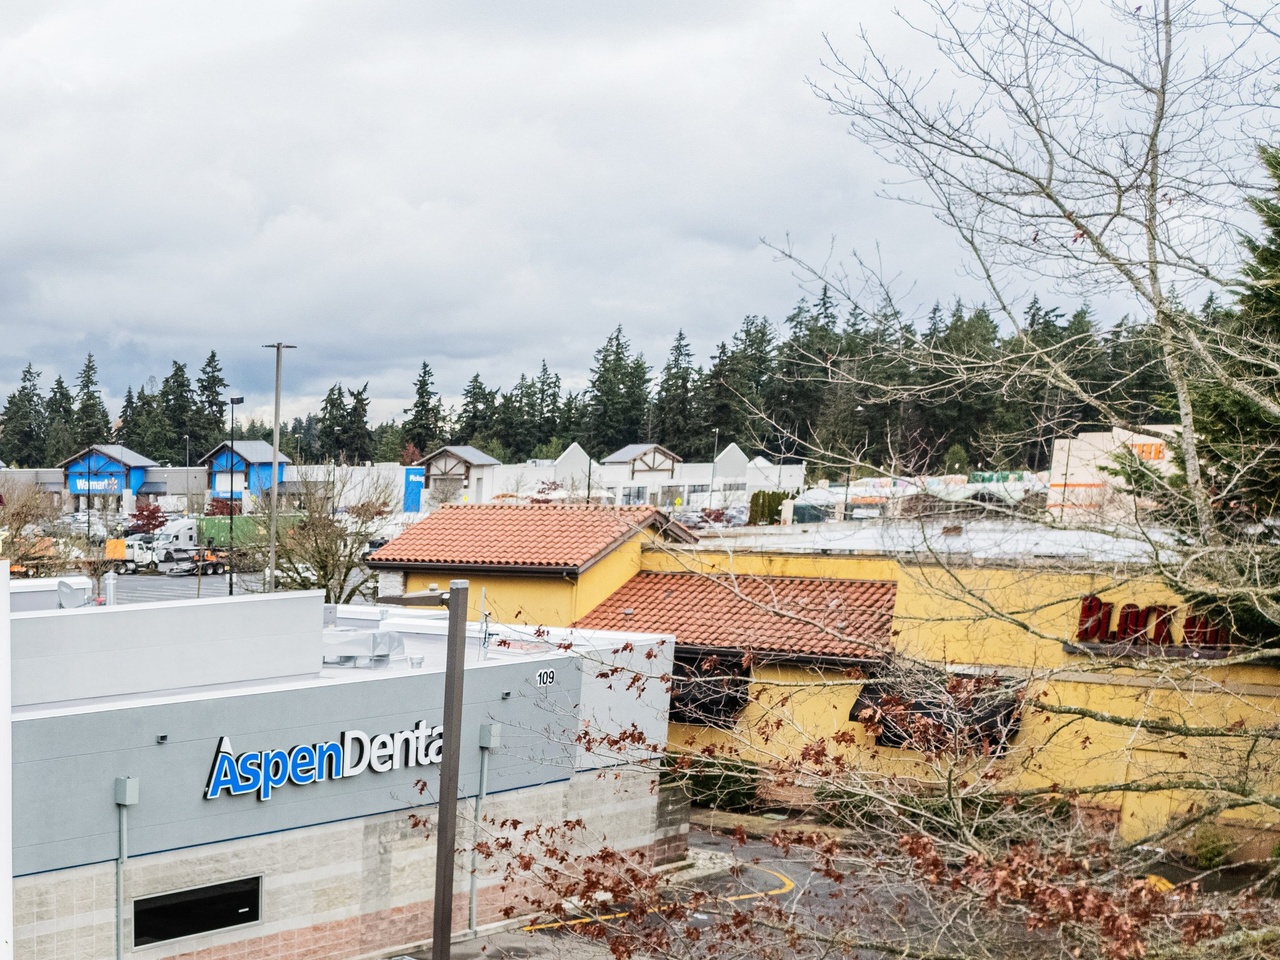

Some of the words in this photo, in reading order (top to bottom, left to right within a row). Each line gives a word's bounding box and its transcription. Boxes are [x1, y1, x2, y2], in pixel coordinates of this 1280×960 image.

[76, 478, 108, 490] Wamart
[536, 669, 555, 686] 109
[205, 720, 444, 800] AspenDenta
